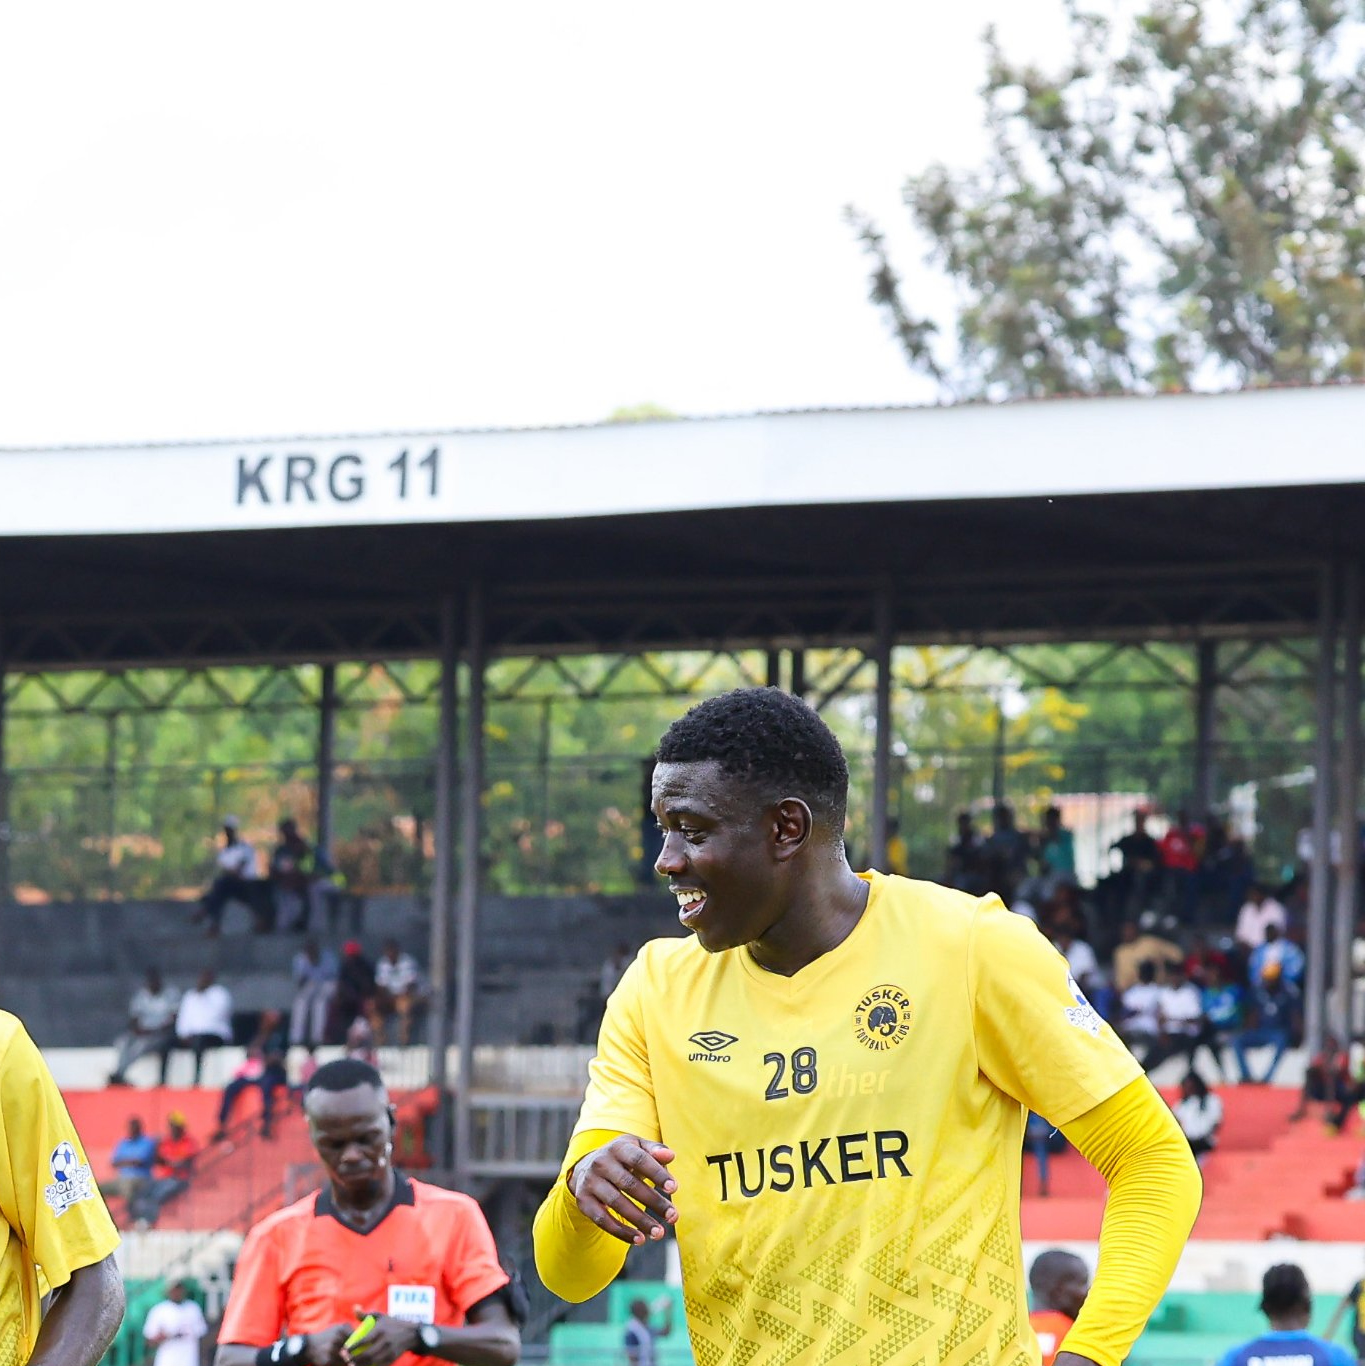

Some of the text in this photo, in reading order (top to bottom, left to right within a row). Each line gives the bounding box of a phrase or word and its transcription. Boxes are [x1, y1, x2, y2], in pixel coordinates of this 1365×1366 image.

[237, 447, 438, 504] KRG 11
[855, 989, 910, 1013] TUSKER
[855, 1024, 910, 1051] FOOTBALL CLUB
[688, 1051, 731, 1063] umbro
[763, 1046, 818, 1101] 28
[705, 1130, 913, 1202] TUSKER
[394, 1290, 429, 1304] FIFA
